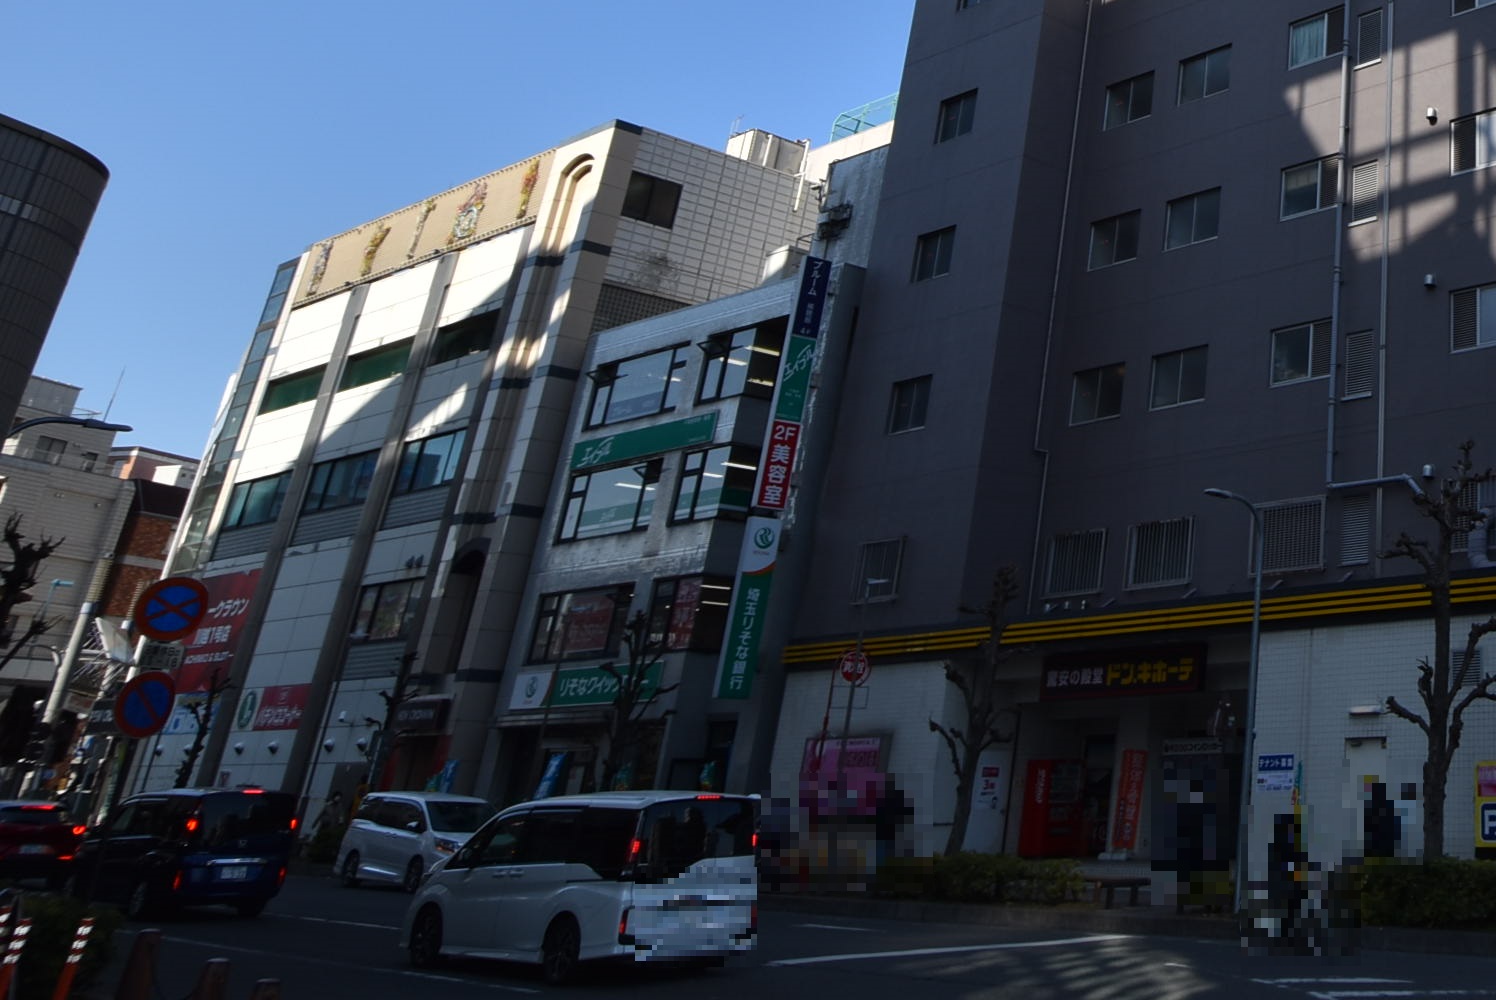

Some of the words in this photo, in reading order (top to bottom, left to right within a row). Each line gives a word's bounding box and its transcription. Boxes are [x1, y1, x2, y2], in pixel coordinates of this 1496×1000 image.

[773, 425, 798, 441] 2F
[762, 444, 792, 506] 美容室
[729, 587, 761, 690] 埼玉りそな銀行
